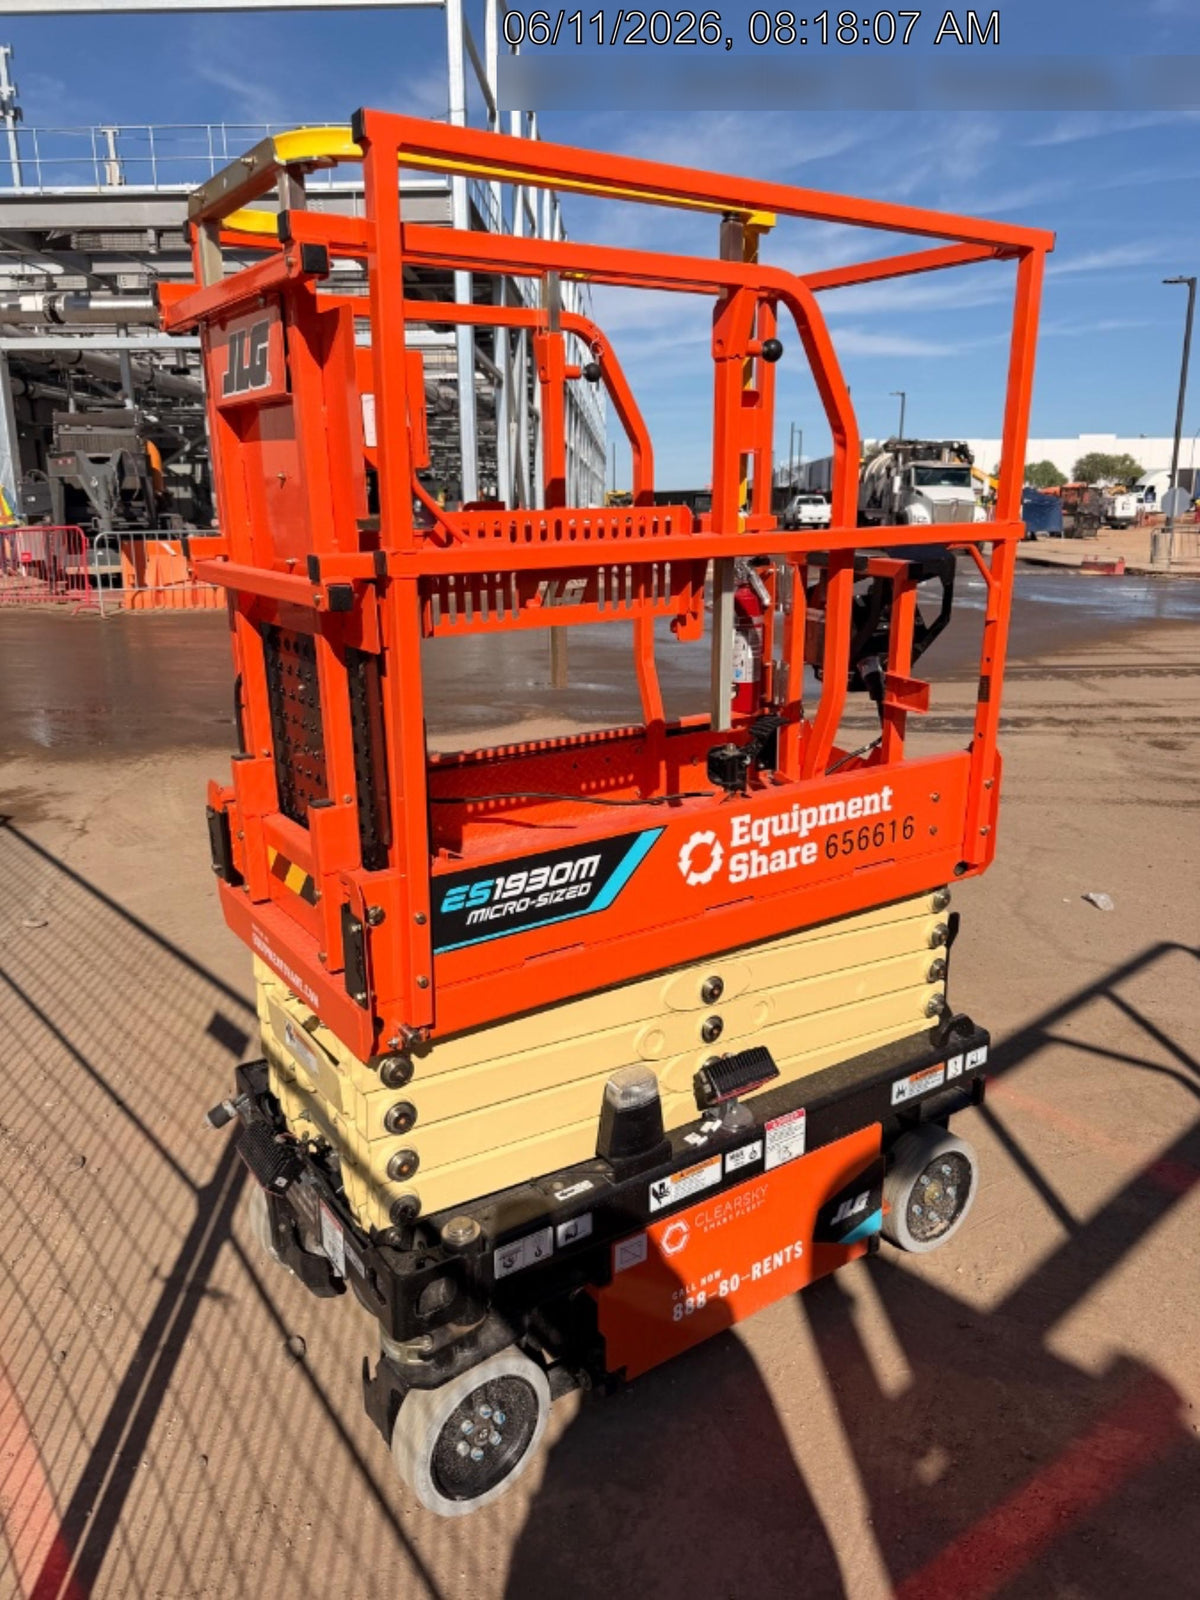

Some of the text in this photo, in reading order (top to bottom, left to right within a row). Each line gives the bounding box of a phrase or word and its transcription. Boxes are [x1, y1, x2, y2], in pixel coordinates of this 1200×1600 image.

[222, 319, 271, 398] JLG
[526, 578, 588, 608] JLG
[730, 785, 893, 848] Equipment
[825, 815, 915, 860] 656616
[440, 854, 602, 913] ES1930M
[728, 842, 818, 884] Share
[465, 882, 592, 925] MICRO-SIZED
[694, 1184, 769, 1228] CLEARSKY
[672, 1239, 804, 1322] 888-80-RENTS
[672, 1268, 722, 1300] CALL NOW
